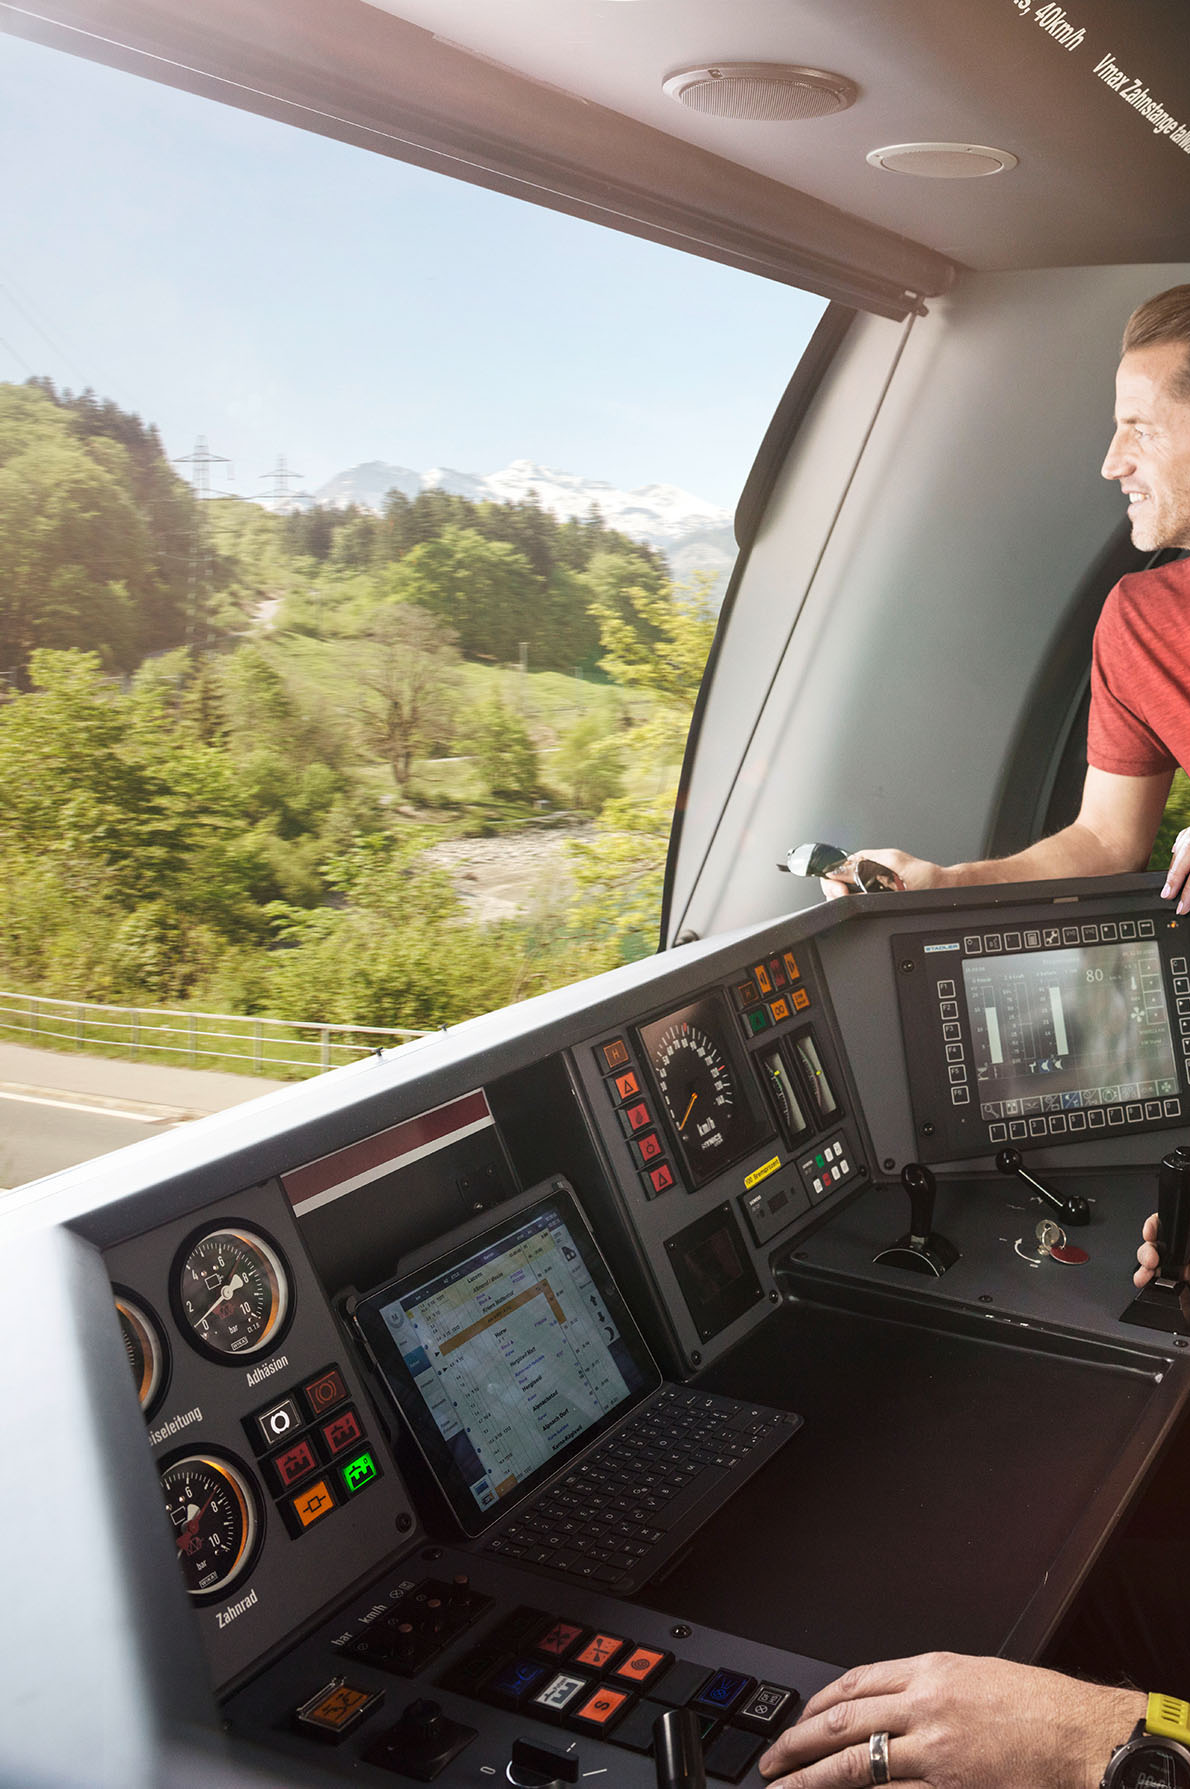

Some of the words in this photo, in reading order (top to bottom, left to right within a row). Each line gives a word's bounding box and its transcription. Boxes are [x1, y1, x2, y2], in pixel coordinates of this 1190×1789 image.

[1034, 2, 1086, 51] 40km/h
[1093, 53, 1130, 92] Vmax
[1119, 78, 1179, 134] Zahnstange
[1086, 968, 1104, 982] 80
[218, 1255, 225, 1267] 6
[192, 1269, 199, 1280] 4
[242, 1272, 249, 1283] 8
[186, 1301, 194, 1312] 2
[240, 1301, 251, 1315] 10
[201, 1319, 209, 1330] 0
[228, 1325, 239, 1334] bar
[246, 1355, 289, 1387] Adhäsion
[185, 1486, 192, 1498] 6
[210, 1501, 218, 1512] 8
[209, 1533, 220, 1547] 10
[196, 1560, 207, 1571] bar
[216, 1588, 259, 1629] Zahnrad
[358, 1603, 388, 1625] km/h
[331, 1631, 353, 1647] bar
[594, 1701, 610, 1711] S
